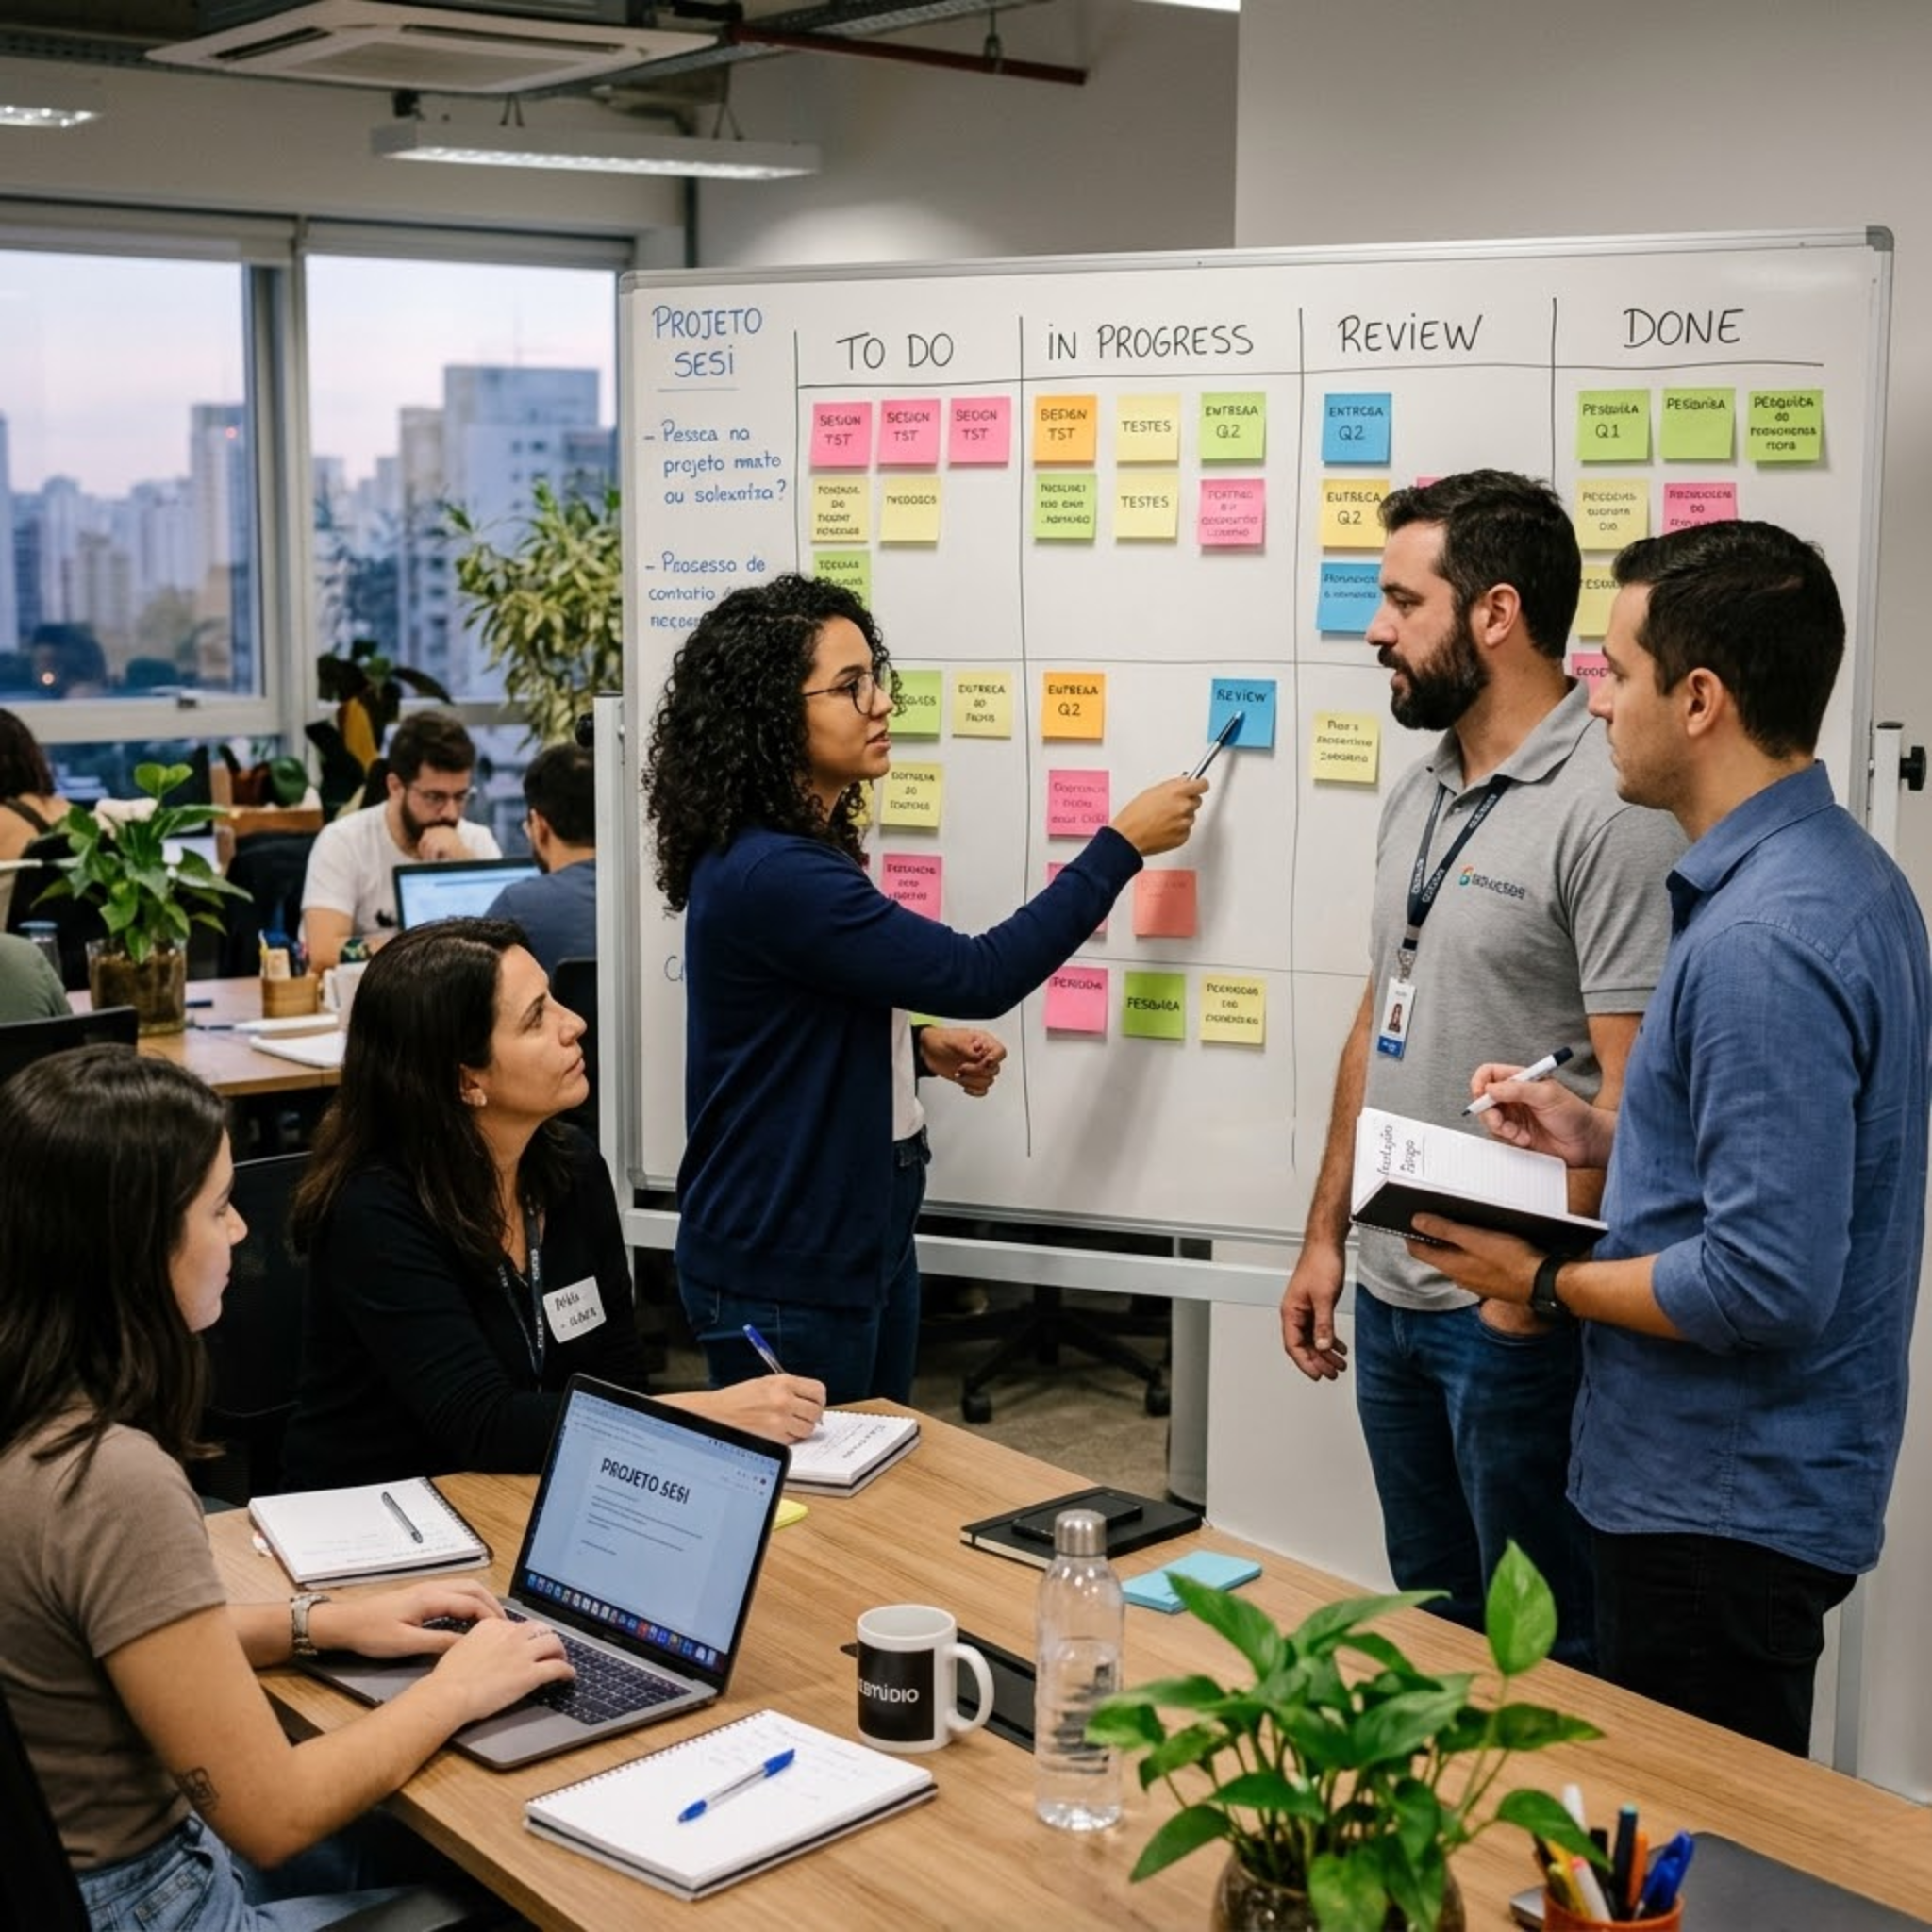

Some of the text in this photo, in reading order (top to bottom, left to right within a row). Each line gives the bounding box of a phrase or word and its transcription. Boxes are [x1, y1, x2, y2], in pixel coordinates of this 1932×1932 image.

[652, 305, 762, 340] PROJETO
[1624, 308, 1744, 348] DONE
[1097, 324, 1254, 359] PROGRESS
[836, 332, 954, 369] TO DO
[1122, 420, 1172, 433] TESTES
[1339, 425, 1365, 441] Q2
[1595, 424, 1620, 438] Q1
[824, 433, 853, 445] TST
[894, 430, 919, 441] TST
[962, 428, 988, 440] TST
[1047, 427, 1076, 441] TST
[1121, 496, 1169, 508] TESTES
[1337, 510, 1362, 525] Q2
[746, 555, 765, 572] de
[1058, 703, 1081, 716] Q2
[600, 1457, 691, 1504] PROJETO SESI
